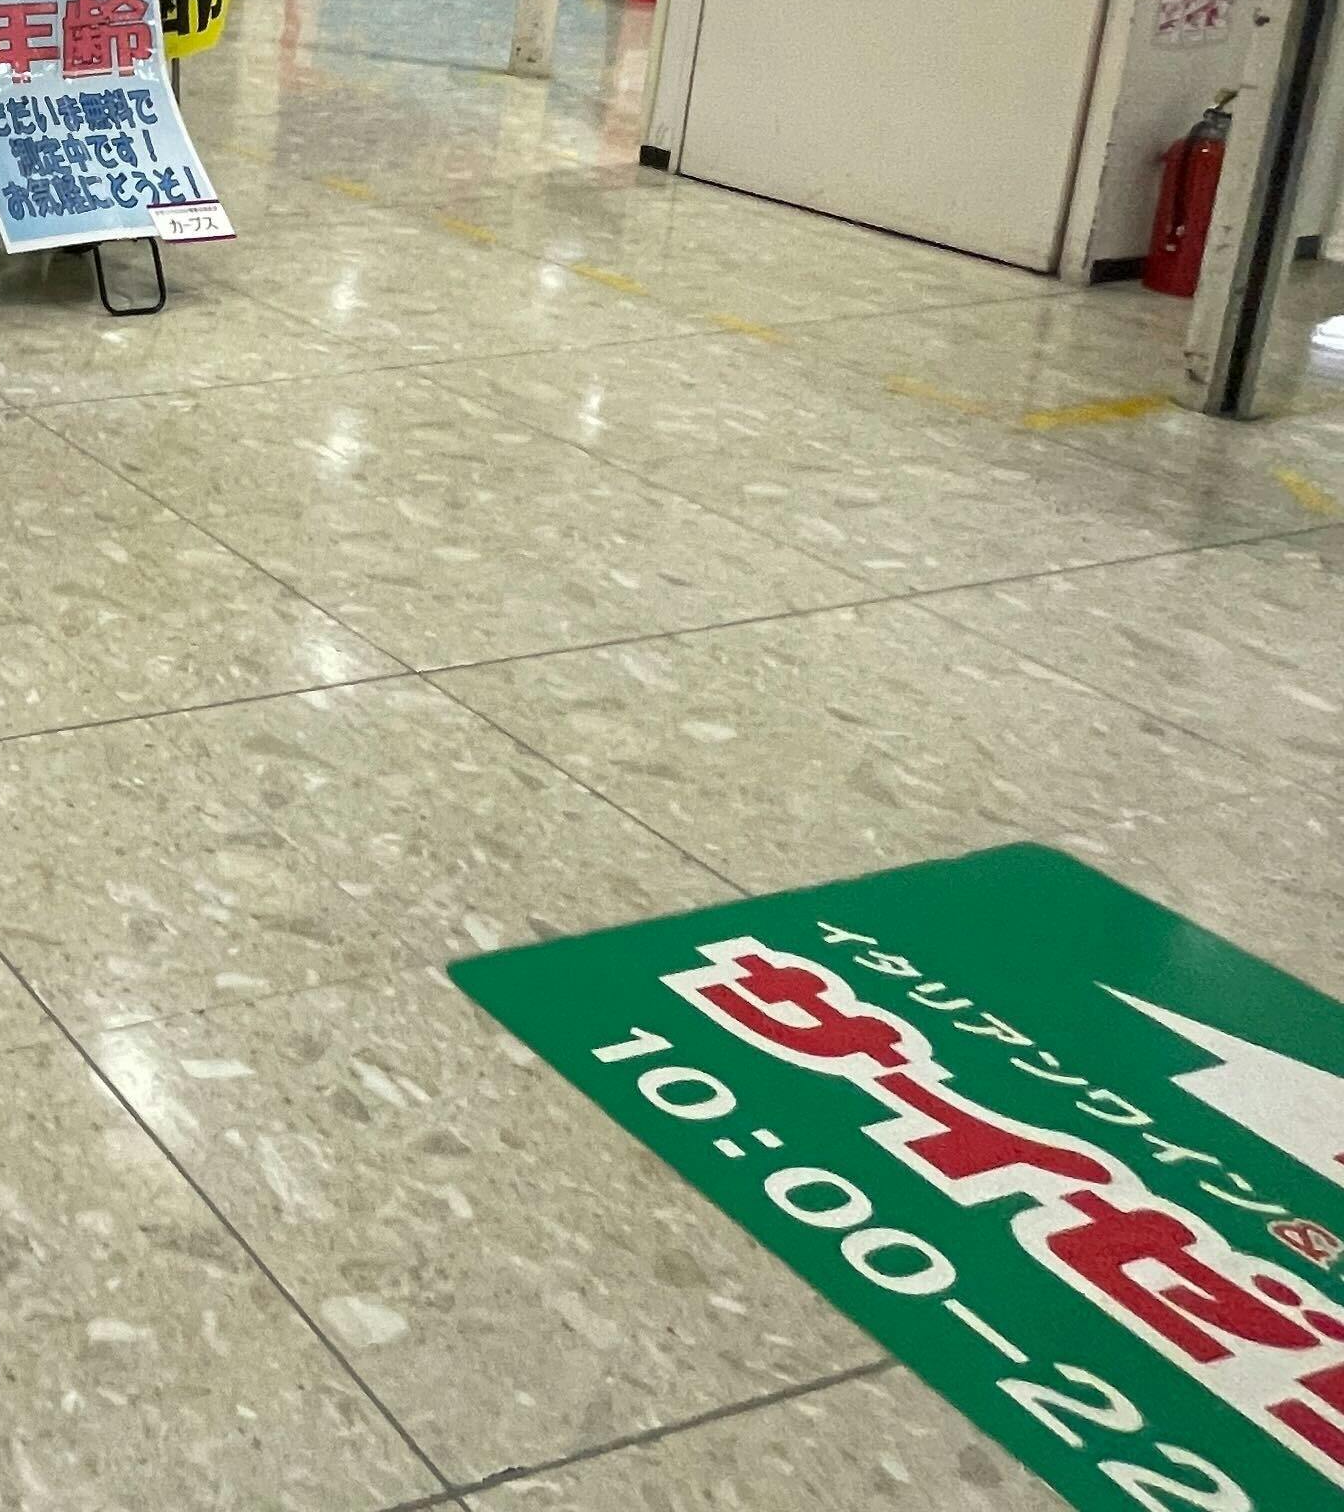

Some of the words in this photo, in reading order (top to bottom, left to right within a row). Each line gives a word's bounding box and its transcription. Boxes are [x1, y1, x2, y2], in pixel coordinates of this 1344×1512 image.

[815, 920, 1344, 1273] イタリアンワイン&
